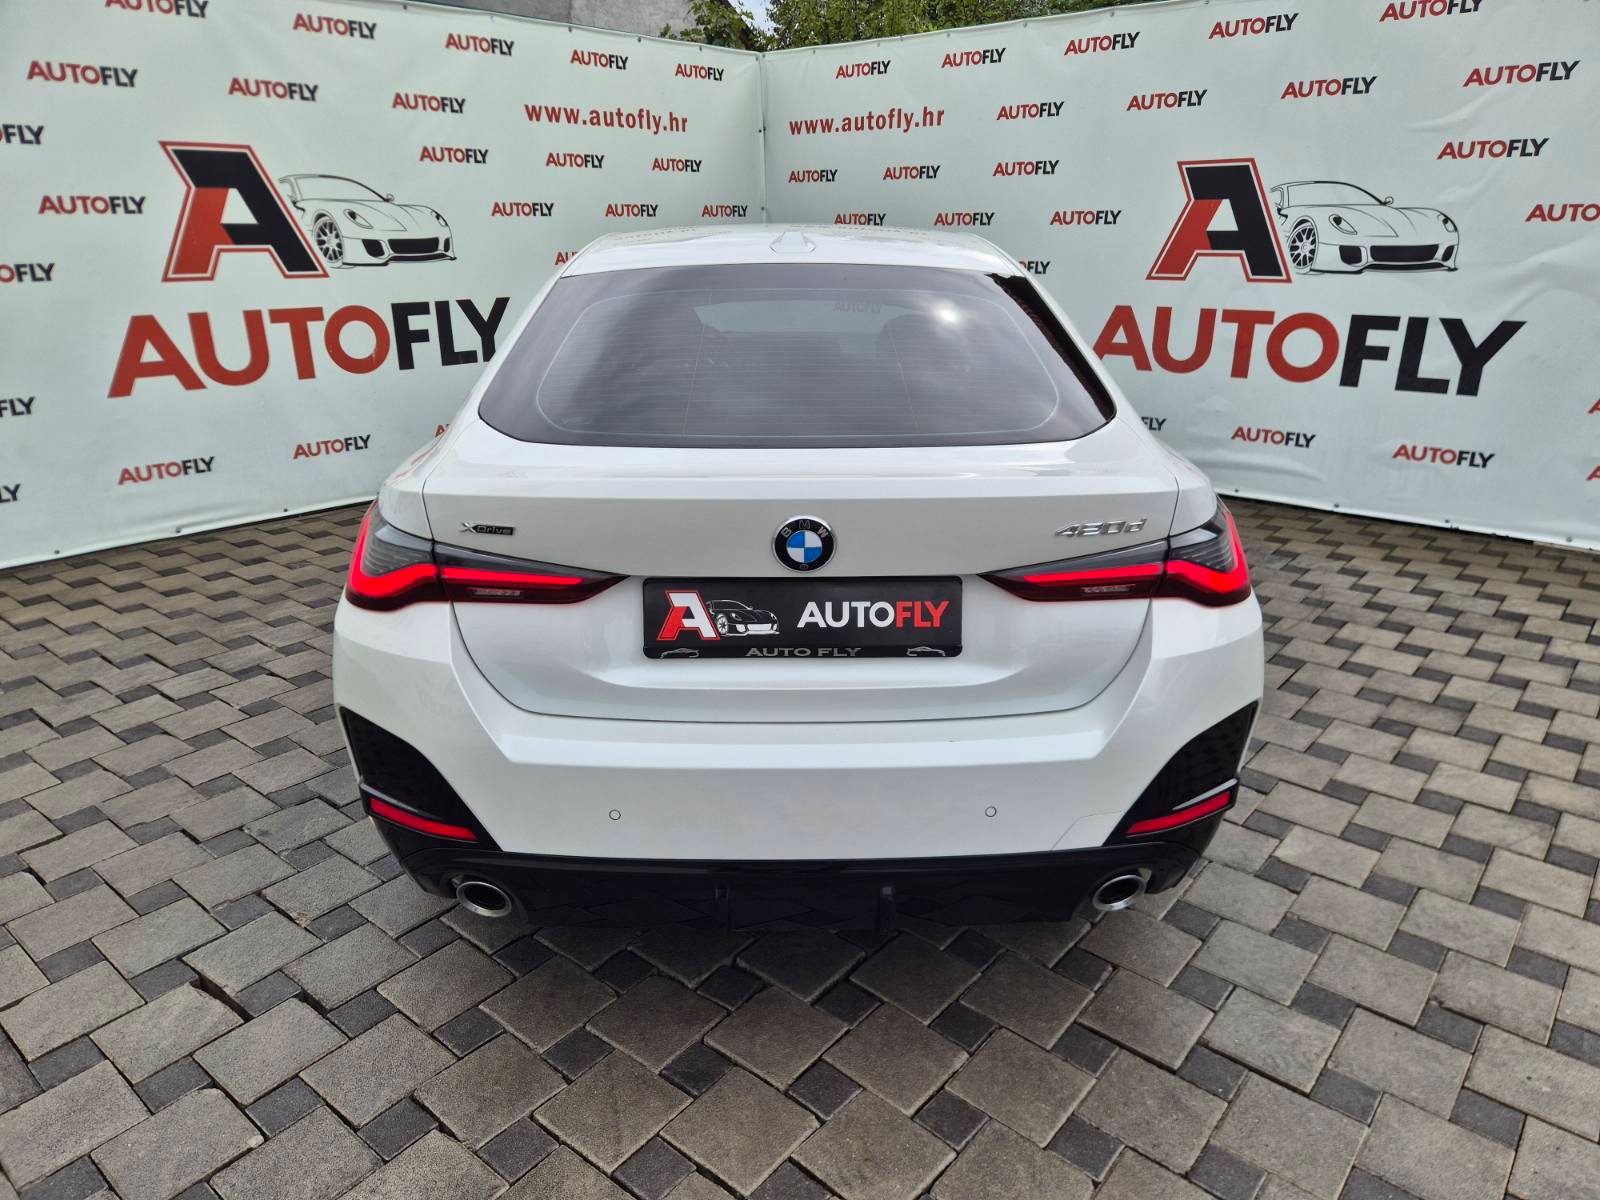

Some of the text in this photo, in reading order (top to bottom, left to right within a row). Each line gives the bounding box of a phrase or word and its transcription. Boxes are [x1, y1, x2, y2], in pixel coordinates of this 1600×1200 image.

[1379, 0, 1482, 22] AUTOFLY
[293, 14, 376, 39] AUTOFLY
[1208, 13, 1299, 39] AUTOFLY
[445, 33, 514, 56] AUTOFLY
[1064, 32, 1140, 56] AUTOFLY
[571, 50, 628, 70] AUTOFLY
[941, 48, 1006, 68] AUTOFLY
[27, 61, 138, 87] AUTOFLY
[675, 64, 724, 81] AUTOFLY
[836, 60, 891, 79] AUTOFLY
[1463, 60, 1580, 87] AUTOFLY
[229, 78, 318, 101] AUTOFLY
[1281, 76, 1377, 99] AUTOFLY
[392, 93, 465, 114] AUTOFLY
[997, 101, 1064, 120] AUTOFLY
[1127, 89, 1207, 111] AUTOFLY
[524, 104, 687, 135] www.autofly.hr
[790, 106, 944, 135] www.autofly.hr
[420, 146, 488, 164] AUTOFLY
[1437, 138, 1549, 160] AUTOFLY
[546, 153, 604, 168] AUTOFLY
[652, 158, 702, 172] AUTOFLY
[993, 160, 1059, 176] AUTOFLY
[789, 169, 837, 183] AUTOFLY
[883, 165, 940, 180] AUTOFLY
[39, 196, 146, 214] AUTOFLY
[492, 202, 554, 216] AUTOFLY
[605, 204, 658, 217] AUTOFLY
[702, 205, 747, 217] AUTOFLY
[834, 213, 886, 226] AUTOFLY
[934, 212, 995, 226] AUTOFLY
[1050, 210, 1121, 225] AUTOFLY
[108, 297, 510, 398] AUTOFLY
[1093, 305, 1527, 396] AUTOFLY
[294, 434, 371, 459] AUTOFLY
[1231, 427, 1316, 448] AUTOFLY
[1392, 445, 1495, 468] AUTOFLY
[118, 456, 214, 485] AUTOFLY
[797, 601, 950, 628] AUTOFLY
[746, 647, 862, 657] AUTO FLY
